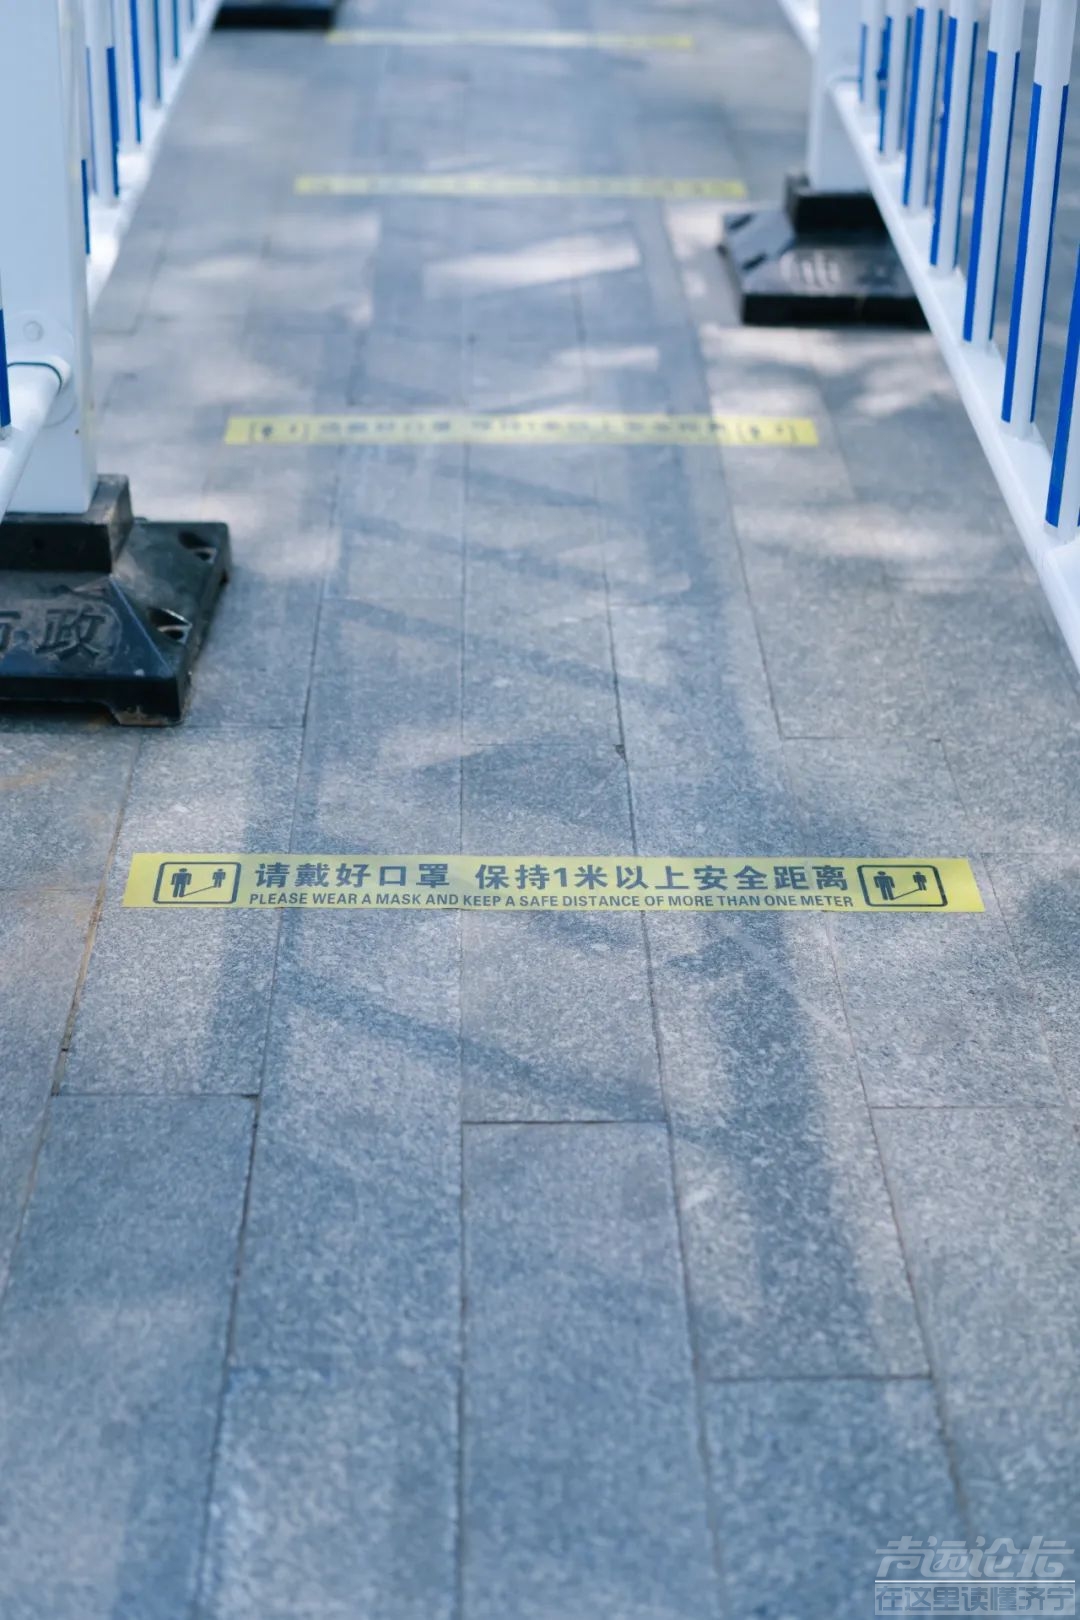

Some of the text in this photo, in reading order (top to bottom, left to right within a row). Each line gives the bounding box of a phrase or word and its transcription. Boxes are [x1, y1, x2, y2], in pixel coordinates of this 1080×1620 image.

[255, 862, 848, 891] 请戴好口罩 保持1米以上安全距离
[249, 892, 854, 908] PLEASE WEAR A MASK AND KEEP A SAFE DISTANCE OF MORE THAN ONE METER
